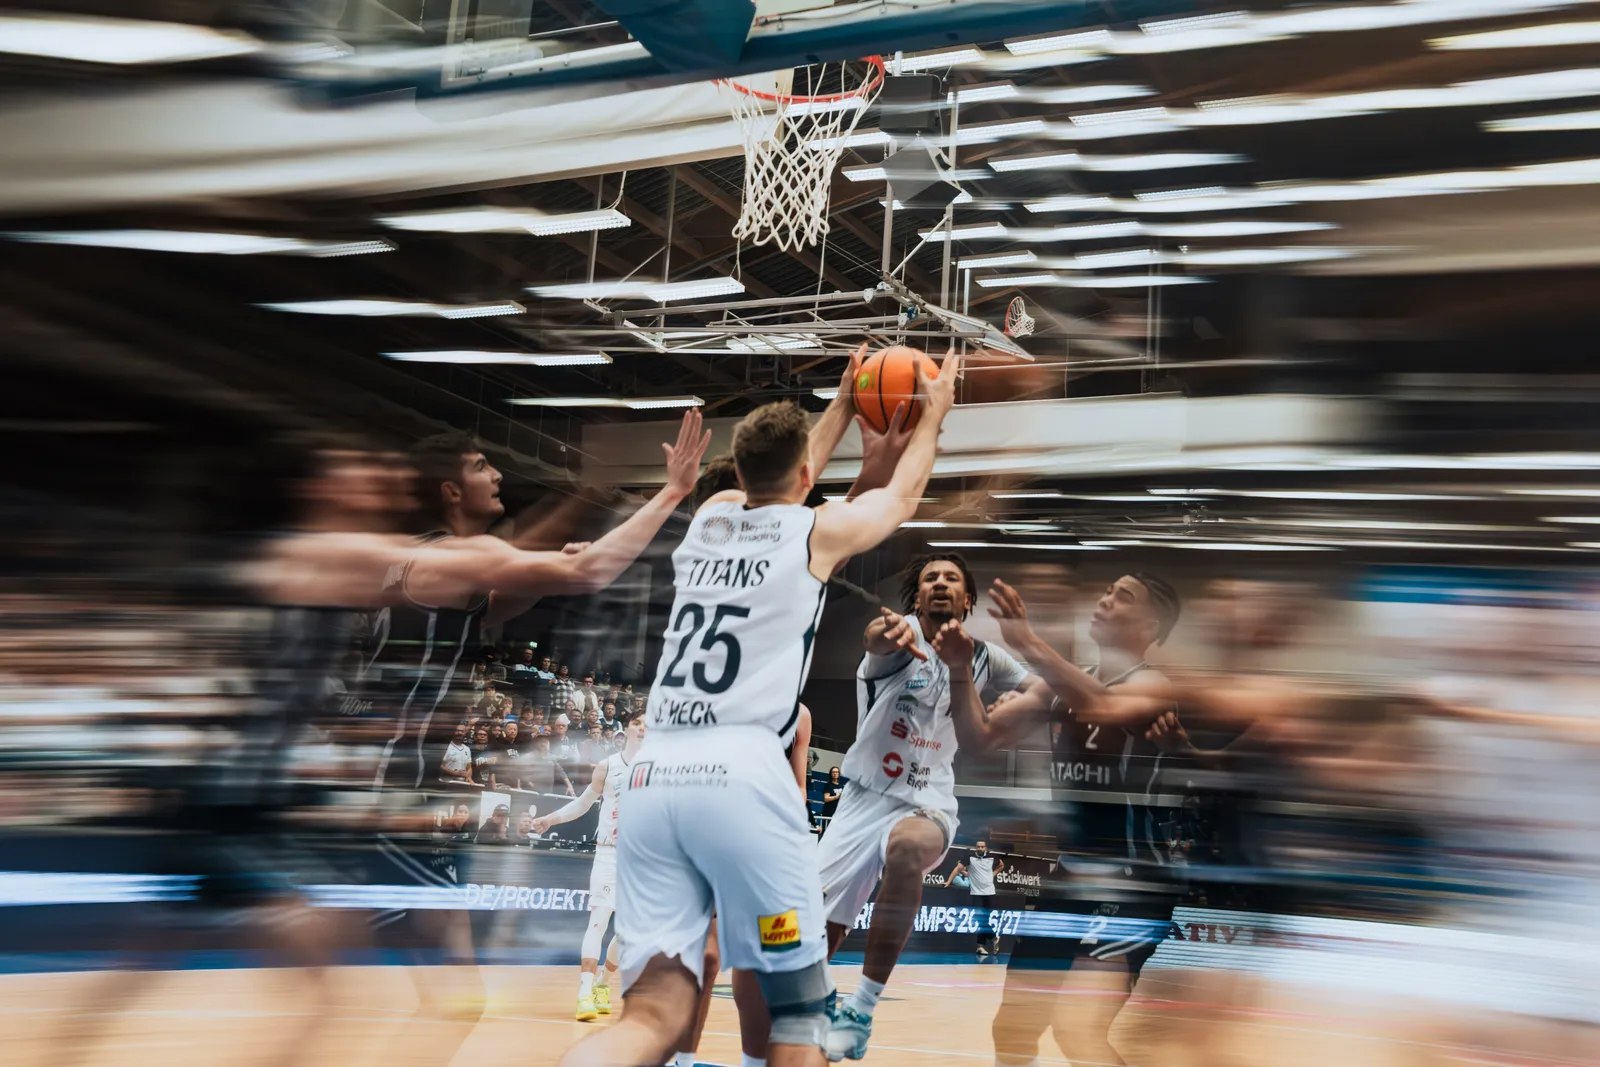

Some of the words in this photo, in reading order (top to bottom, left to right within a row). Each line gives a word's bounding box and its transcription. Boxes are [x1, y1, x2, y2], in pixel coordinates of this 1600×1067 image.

[740, 520, 781, 532] Bed
[687, 558, 770, 588] TITANS
[660, 602, 751, 694] 25
[763, 929, 797, 942] LOTTO
